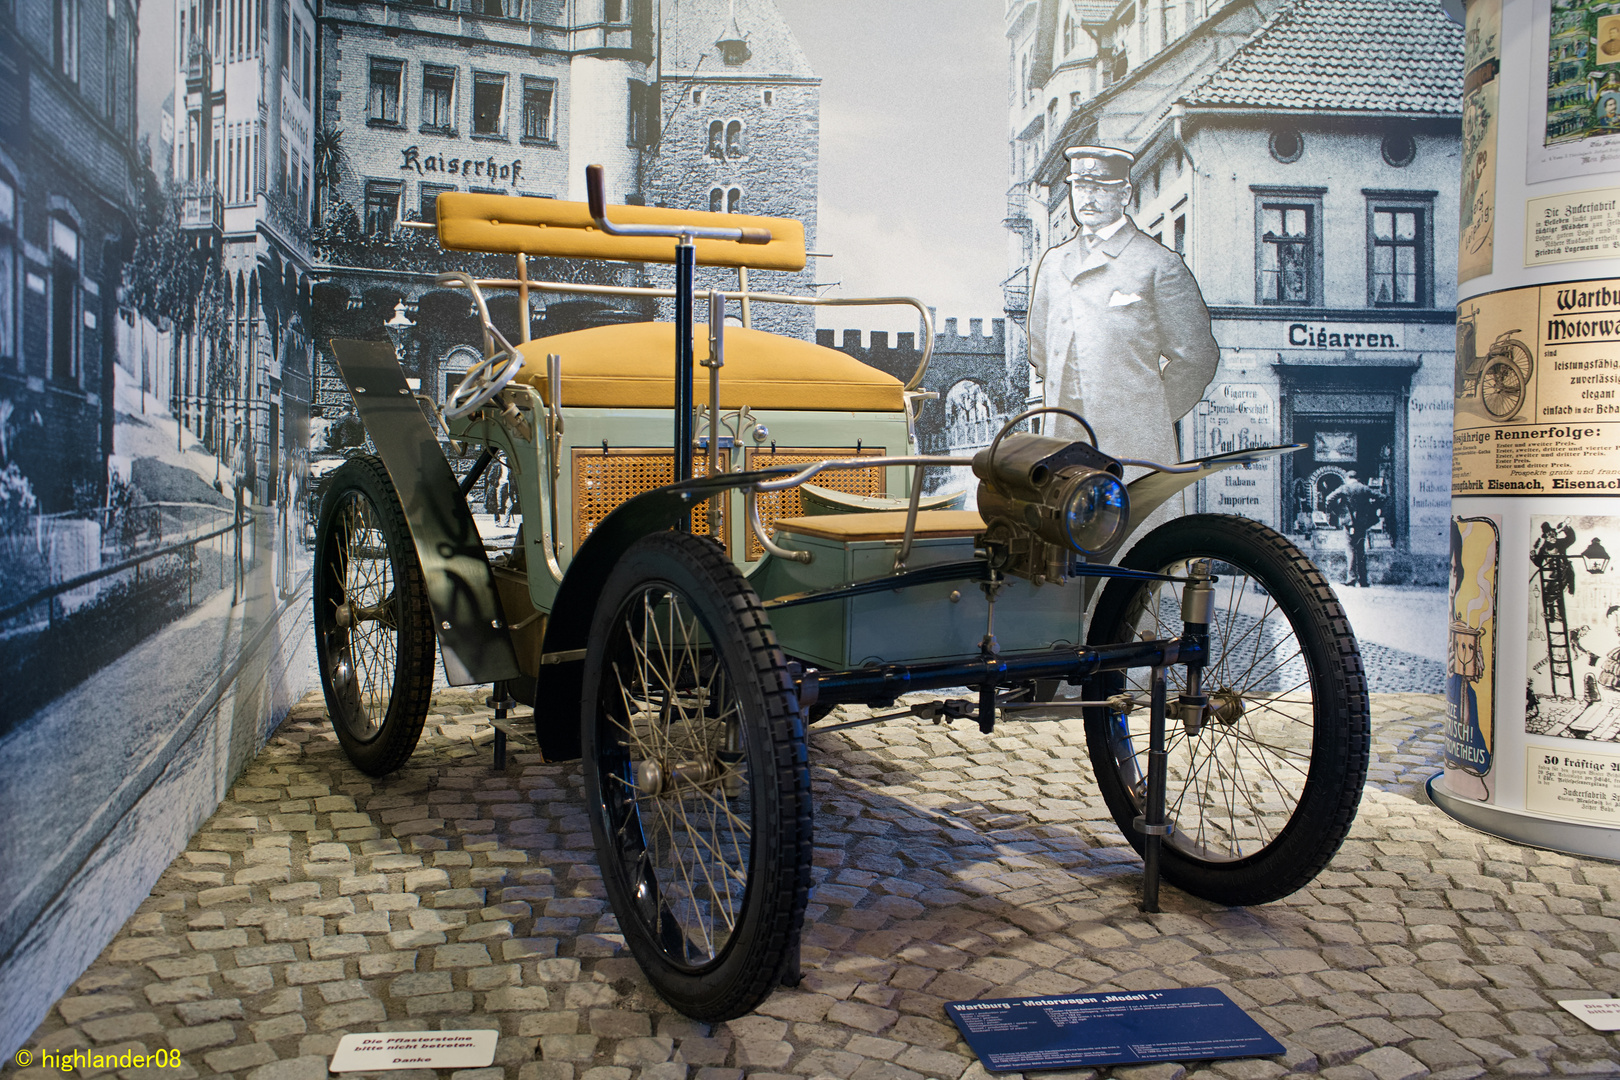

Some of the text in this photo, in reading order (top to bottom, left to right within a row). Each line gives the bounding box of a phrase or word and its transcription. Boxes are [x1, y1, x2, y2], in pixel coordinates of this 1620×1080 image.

[1544, 208, 1559, 218] Die
[1564, 200, 1616, 217] Zuckerfabrik
[1535, 247, 1562, 257] Friedrich
[1289, 324, 1399, 348] Cigarren.
[1581, 390, 1615, 400] elegant
[1543, 404, 1572, 415] einfach
[1210, 427, 1234, 454] Paul
[1494, 427, 1601, 441] Rennerfolge:
[1225, 476, 1256, 487] Habana
[1488, 479, 1545, 492] Eisenach,
[1564, 757, 1605, 771] kräftige
[1563, 787, 1607, 799] Zuckerfabrik
[953, 1002, 1011, 1011] Wartburg
[1022, 997, 1098, 1008] Motorwagen
[386, 1036, 473, 1044] Pflastersteine
